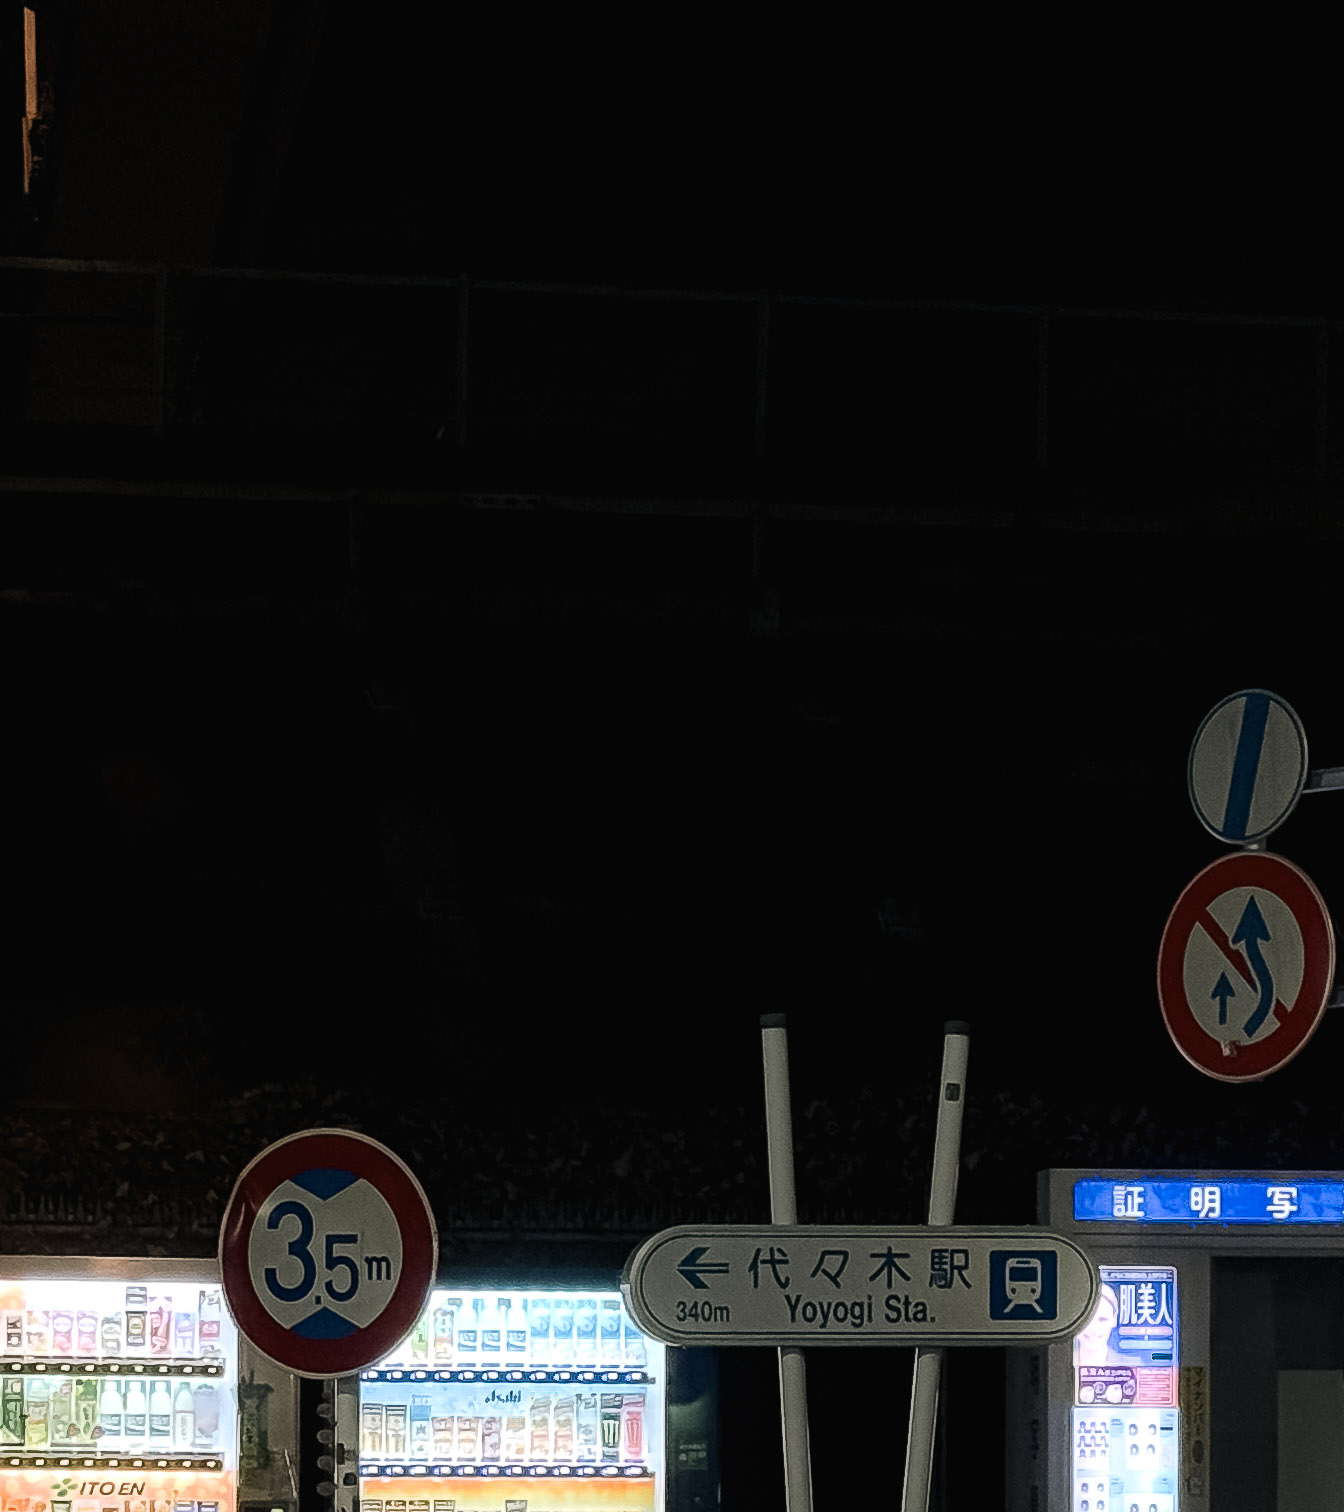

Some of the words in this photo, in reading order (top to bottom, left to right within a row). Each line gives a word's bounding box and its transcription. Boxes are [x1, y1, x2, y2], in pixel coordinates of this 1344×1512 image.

[264, 1200, 392, 1306] 3.5m
[747, 1246, 973, 1291] 代々木駅
[675, 1300, 731, 1324] 340m
[783, 1294, 875, 1329] Yoyogi
[883, 1294, 937, 1324] Sta.
[1119, 1282, 1173, 1325] 肌美人
[79, 1471, 116, 1496] ITO
[117, 1471, 146, 1496] EN
